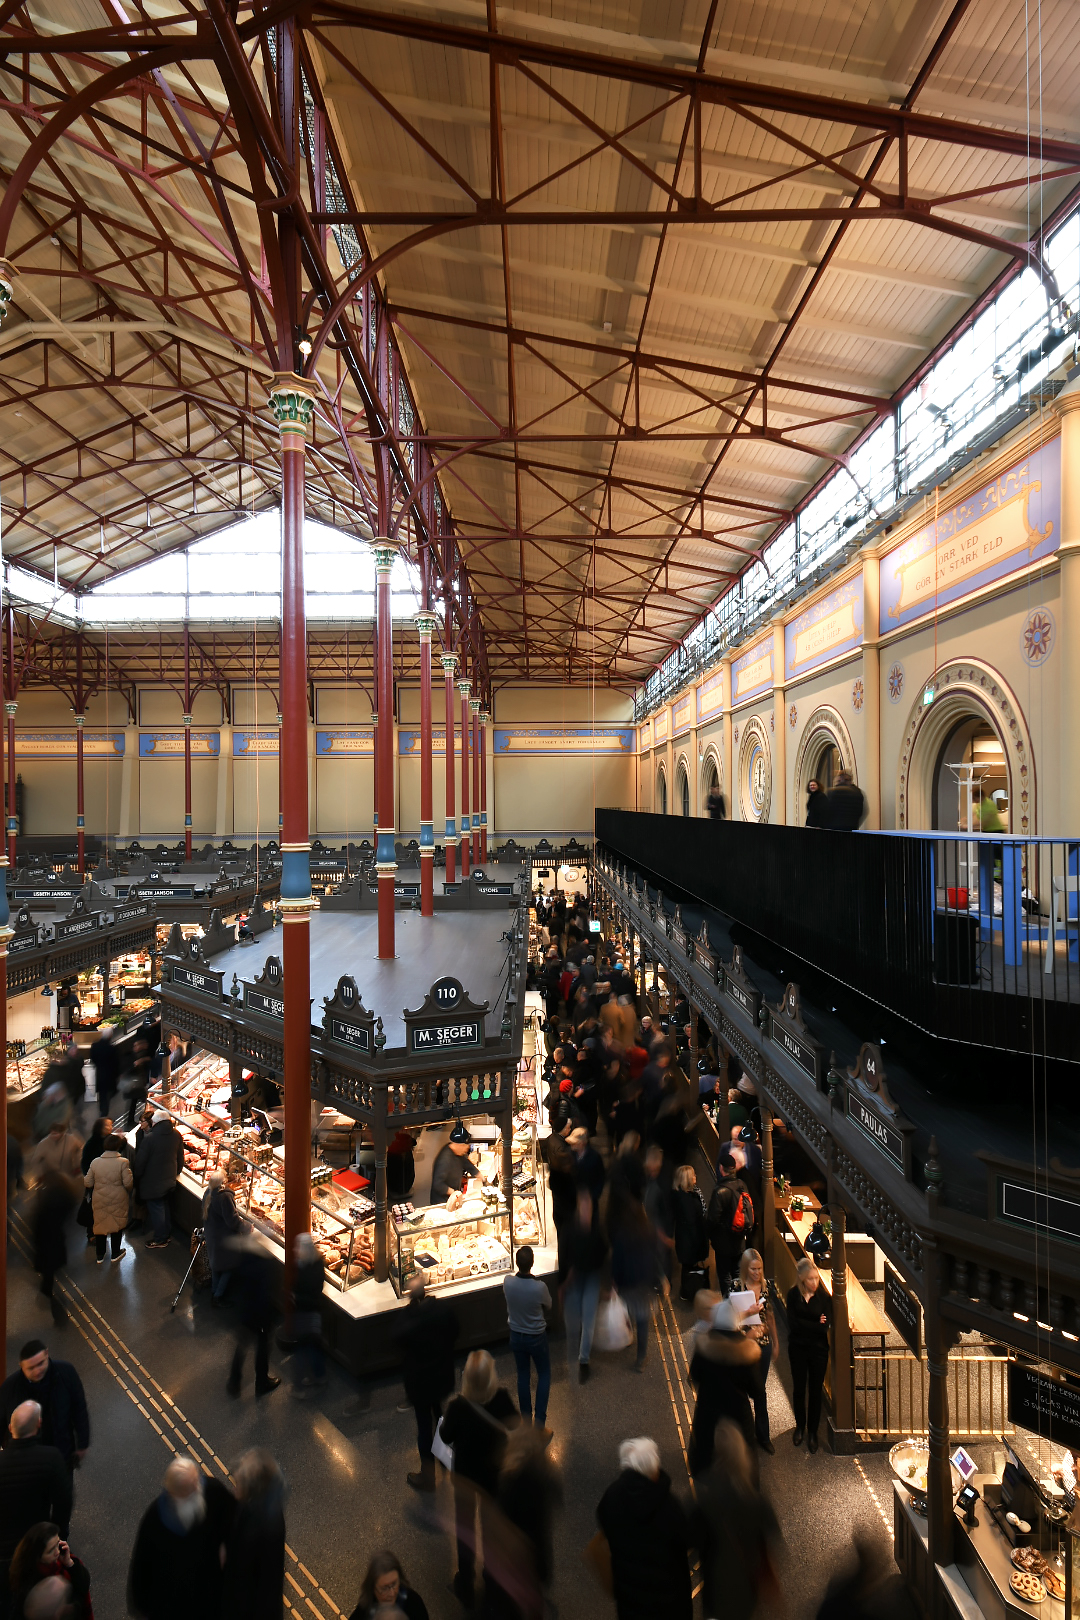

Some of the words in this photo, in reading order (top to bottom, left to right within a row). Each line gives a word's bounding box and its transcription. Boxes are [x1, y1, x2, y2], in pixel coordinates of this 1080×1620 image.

[960, 535, 979, 552] VED
[915, 575, 932, 591] GÖR
[949, 549, 979, 572] STARK
[983, 536, 1003, 554] ELD
[269, 964, 278, 976] 111
[192, 974, 205, 986] SEGER
[342, 986, 353, 998] 111
[437, 987, 457, 999] 110
[346, 1027, 361, 1038] SEGER
[418, 1031, 434, 1042] M.
[436, 1027, 473, 1040] SEGER
[784, 1034, 801, 1058] PAULAS
[866, 1058, 876, 1075] 64
[860, 1106, 888, 1144] PAULAS
